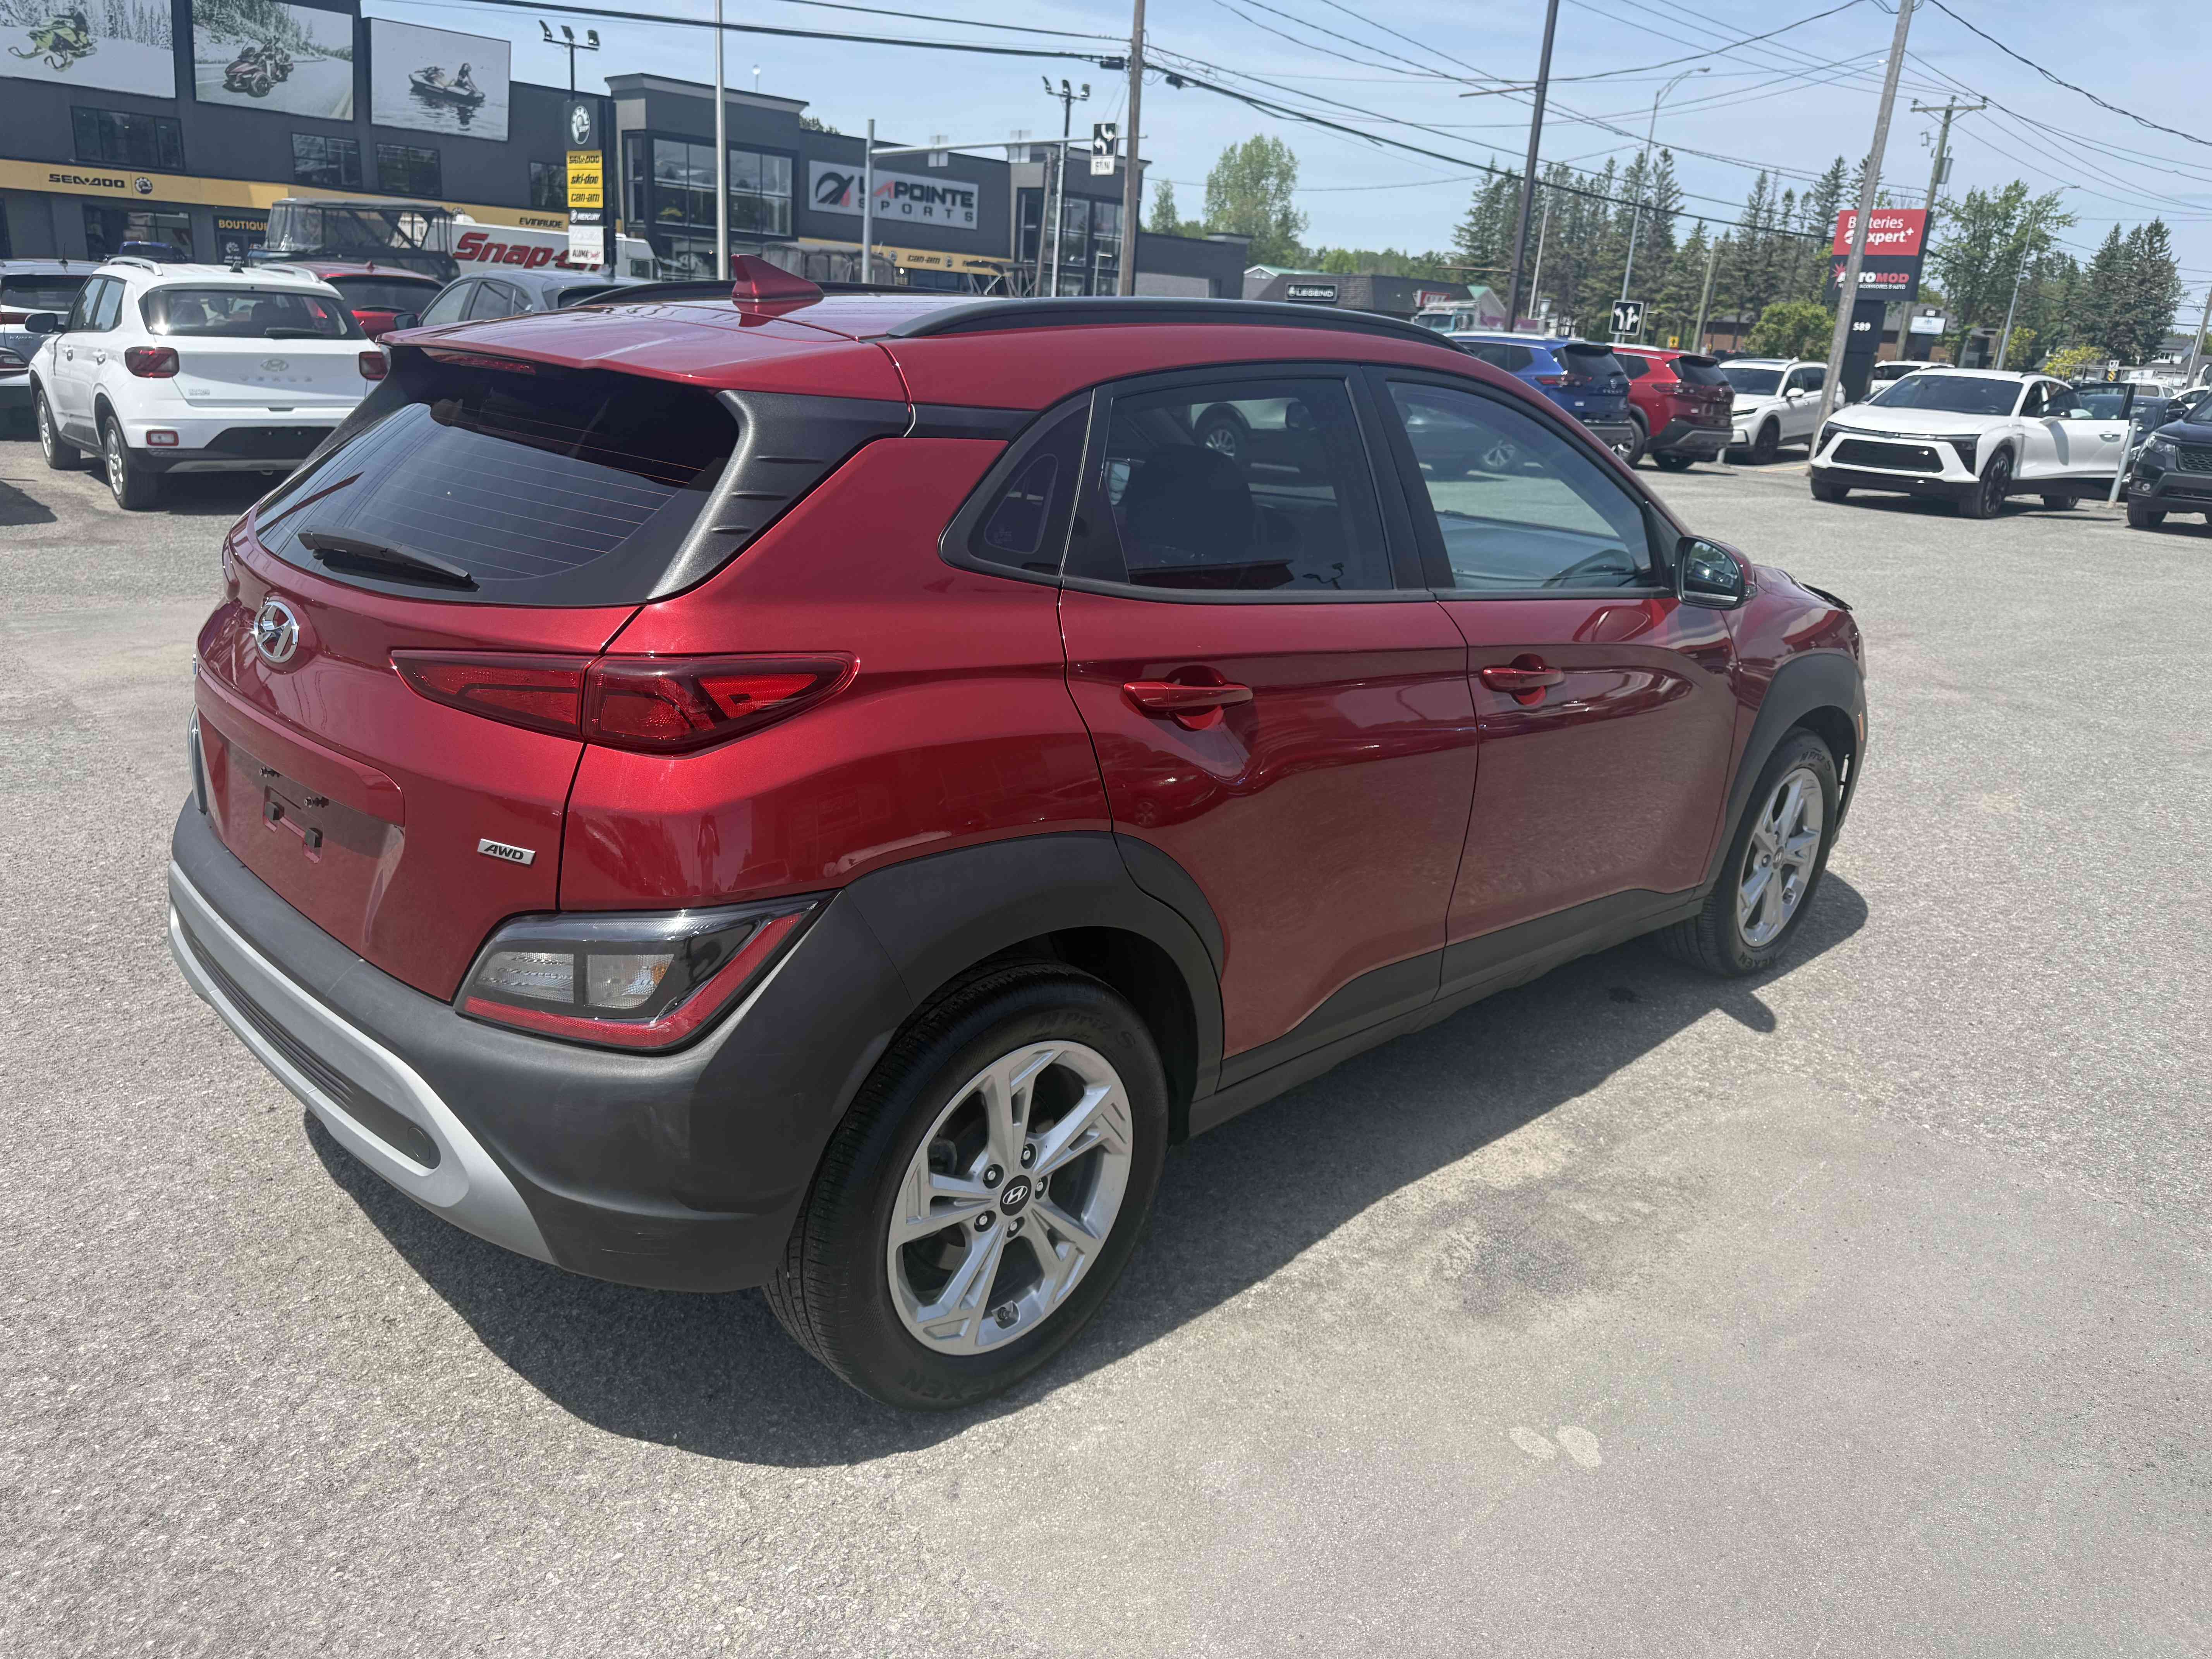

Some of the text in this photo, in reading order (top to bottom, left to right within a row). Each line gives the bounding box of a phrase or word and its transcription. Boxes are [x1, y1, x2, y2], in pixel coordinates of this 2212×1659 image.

[859, 198, 974, 222] SPORTS
[1847, 215, 1904, 229] Bteries
[1837, 271, 1909, 283] ATOMOD
[1296, 288, 1333, 297] LEGEND
[1853, 322, 1871, 331] 589
[484, 844, 524, 860] AWD
